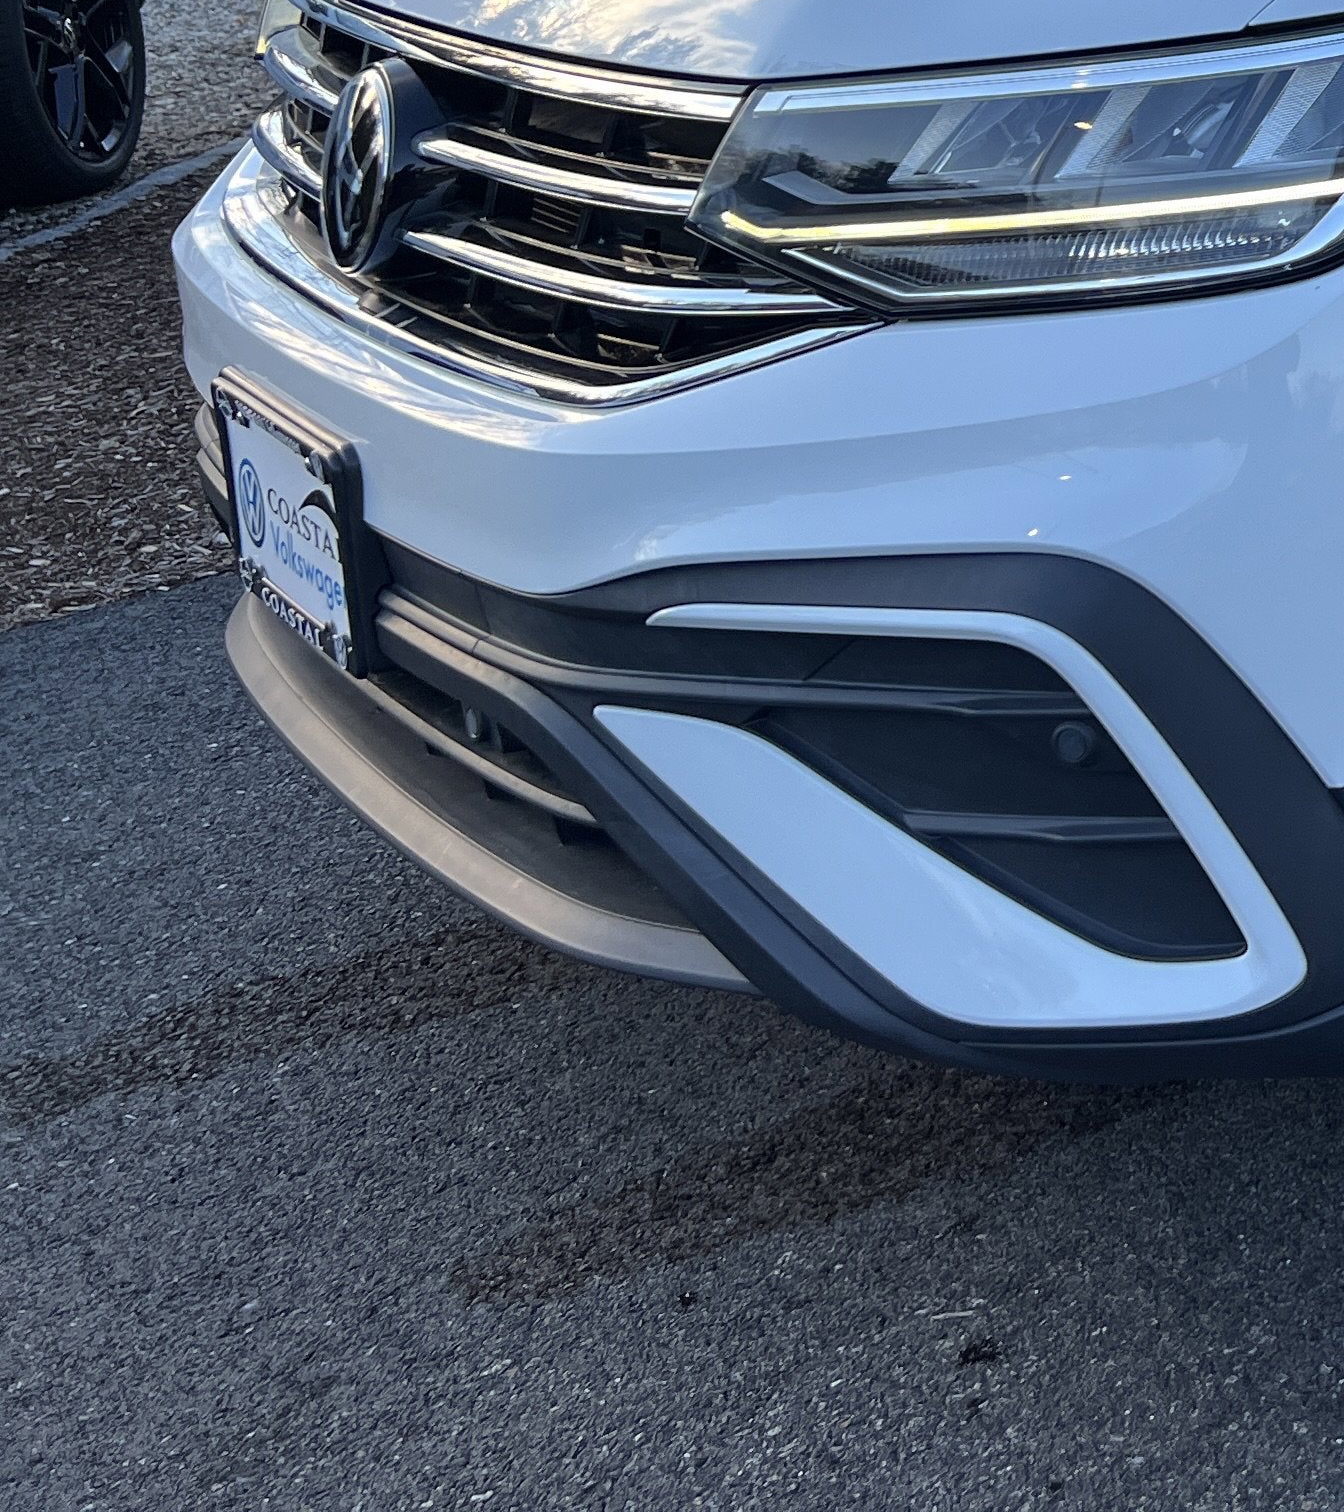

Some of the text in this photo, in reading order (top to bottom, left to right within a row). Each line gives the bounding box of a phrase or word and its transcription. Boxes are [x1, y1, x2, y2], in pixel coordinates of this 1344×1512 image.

[267, 488, 337, 561] COASTA
[270, 519, 345, 611] Volkswage
[261, 586, 324, 651] COASTAL
